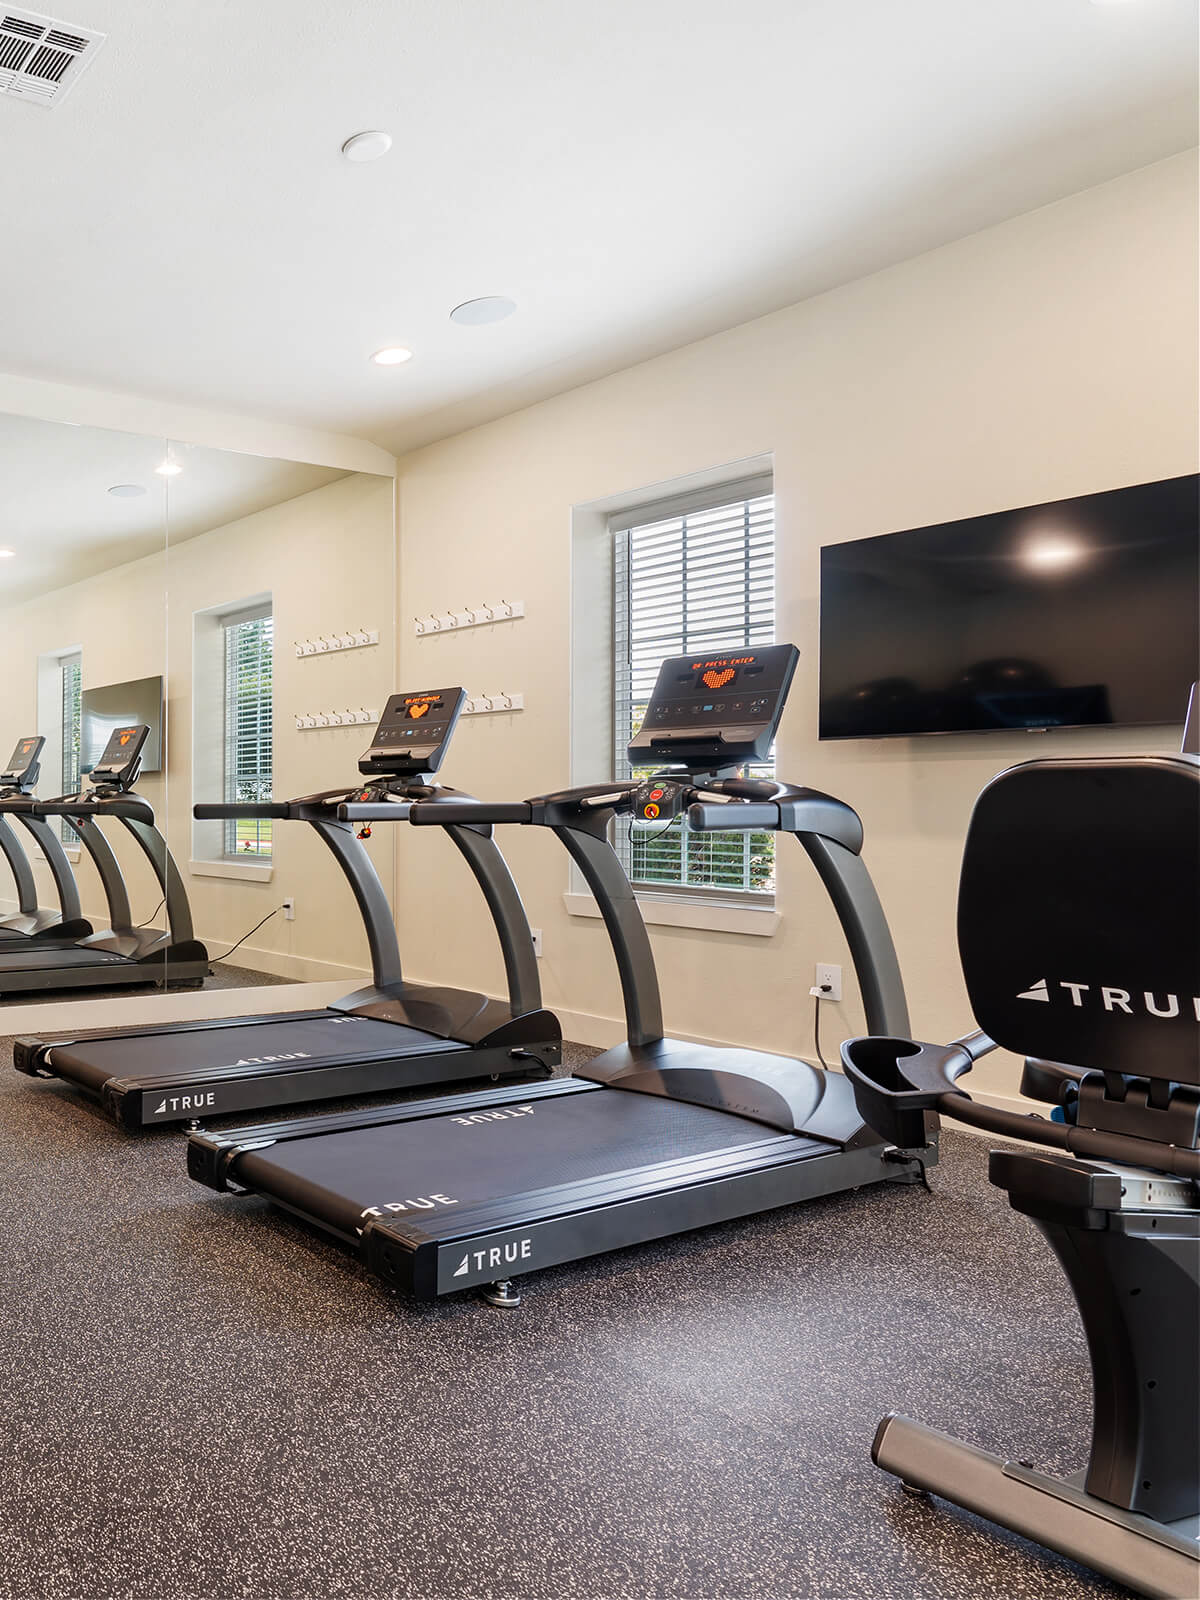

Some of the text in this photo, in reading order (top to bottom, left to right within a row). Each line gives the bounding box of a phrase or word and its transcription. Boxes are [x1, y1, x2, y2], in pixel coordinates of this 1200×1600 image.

[705, 660, 727, 668] PRESS
[730, 657, 754, 665] ENTER
[1060, 981, 1200, 1022] TRU
[247, 1052, 311, 1063] TRUE
[170, 1093, 215, 1111] TRUE
[451, 1108, 524, 1126] TRUE
[360, 1194, 459, 1218] TRUE
[473, 1240, 532, 1271] TRUE
